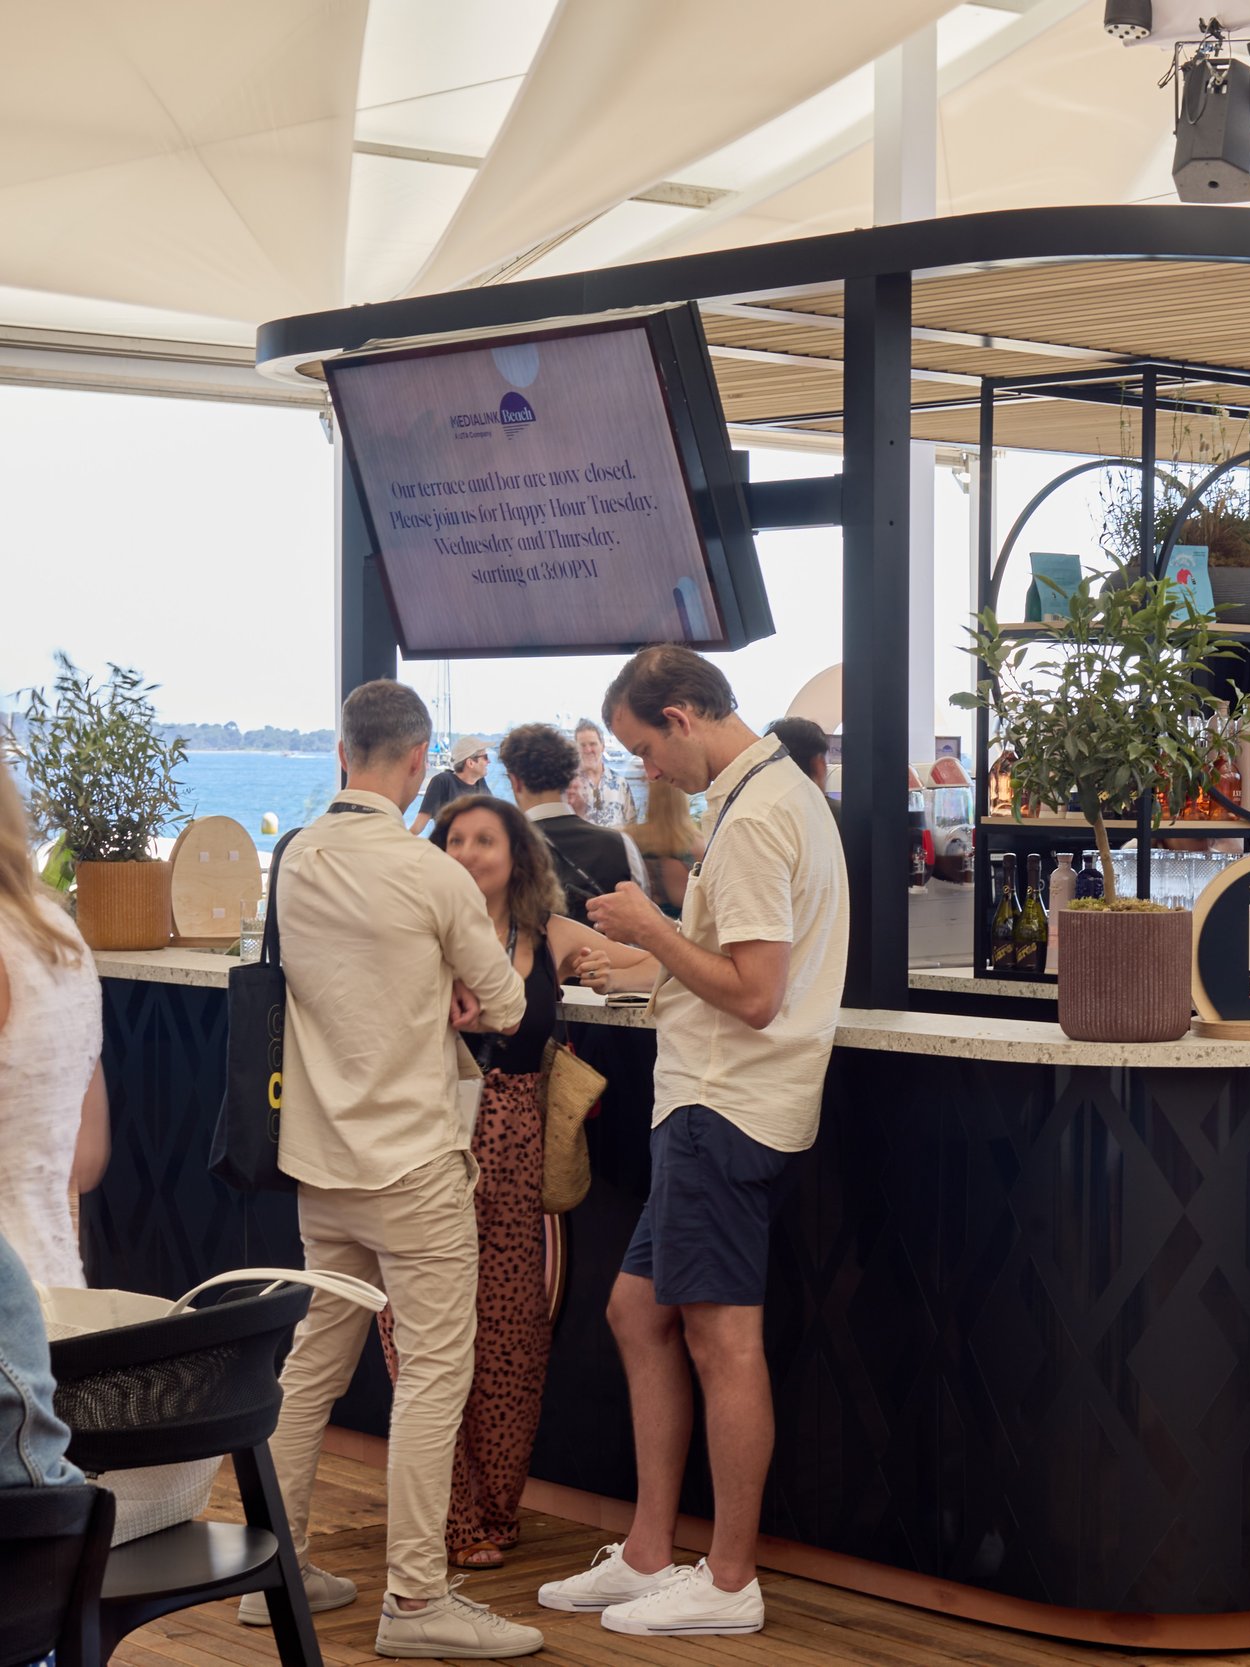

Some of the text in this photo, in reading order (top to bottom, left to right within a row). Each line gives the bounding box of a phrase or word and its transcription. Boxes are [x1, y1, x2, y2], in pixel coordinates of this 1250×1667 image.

[450, 407, 533, 428] MEDIALINK Beach
[391, 459, 636, 499] Our terrace and bar are now closed.
[389, 511, 432, 530] Please
[433, 507, 460, 532] join
[461, 510, 478, 524] us
[478, 504, 498, 523] for
[499, 502, 546, 526] Happy
[549, 498, 586, 518] Hour
[434, 534, 514, 558] Wednesday
[518, 530, 545, 550] and
[472, 559, 598, 588] starting at 3:00PM
